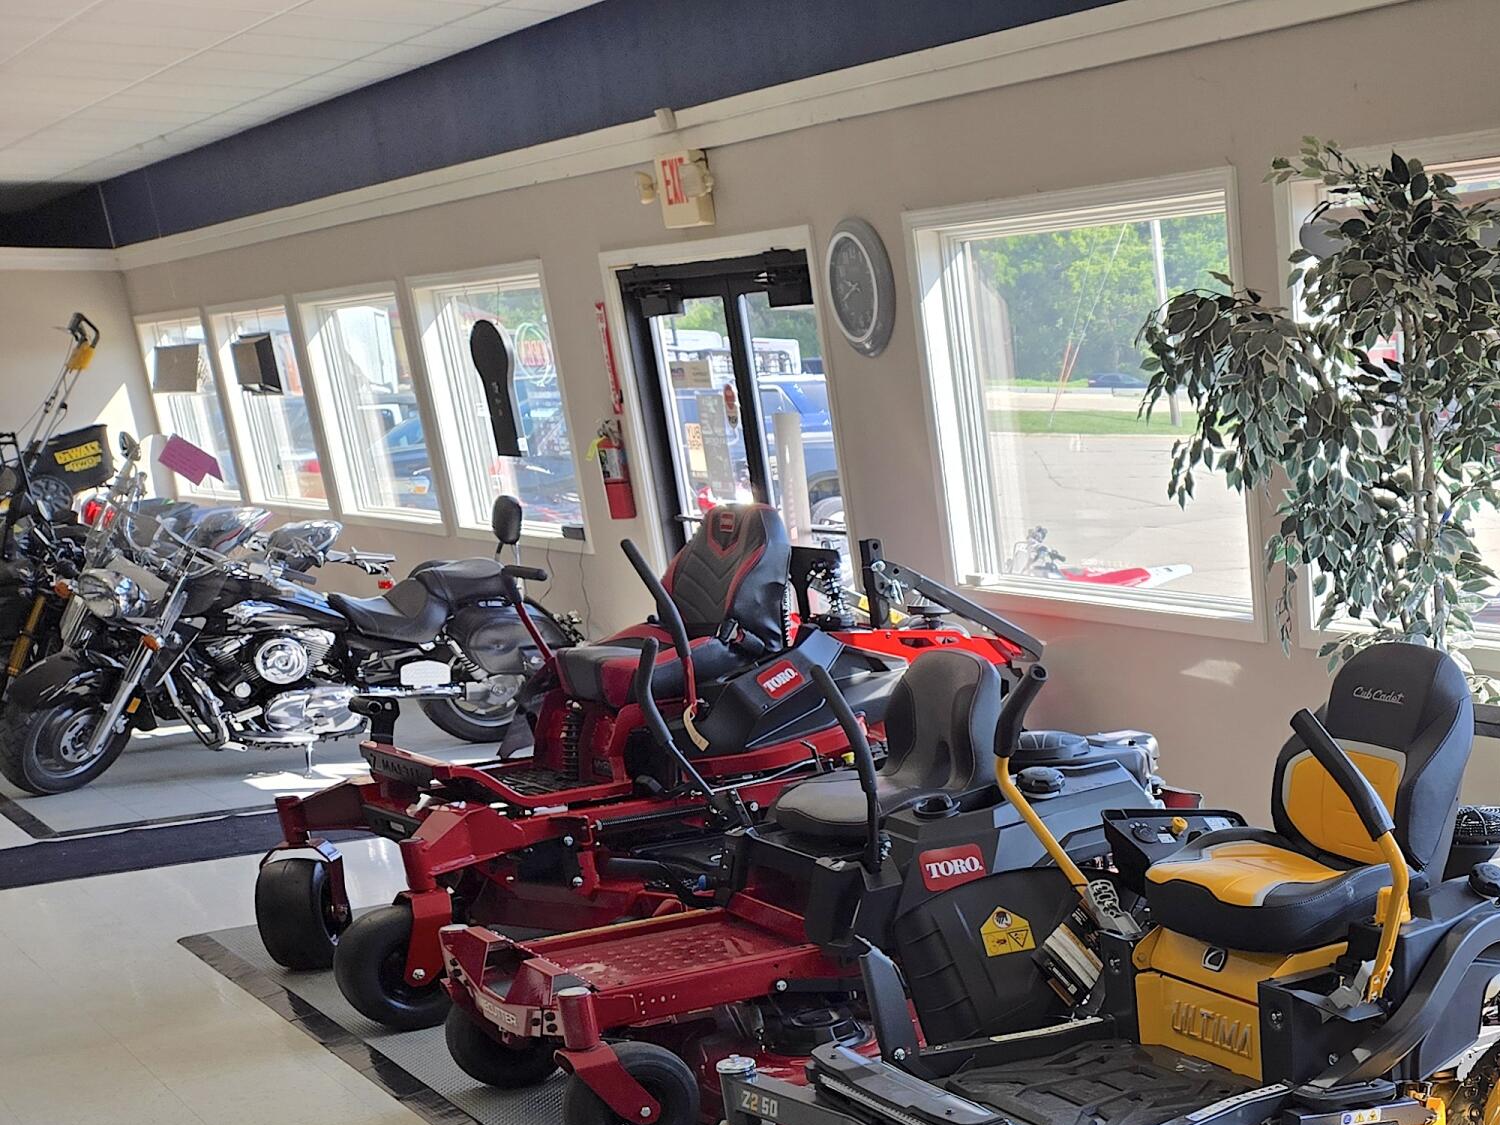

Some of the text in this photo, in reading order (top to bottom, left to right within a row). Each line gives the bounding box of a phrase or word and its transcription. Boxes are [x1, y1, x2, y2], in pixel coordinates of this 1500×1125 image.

[1353, 686, 1405, 705] Cub Cadet
[1172, 1000, 1253, 1060] ULTIMA
[742, 1090, 778, 1118] Z2 50
